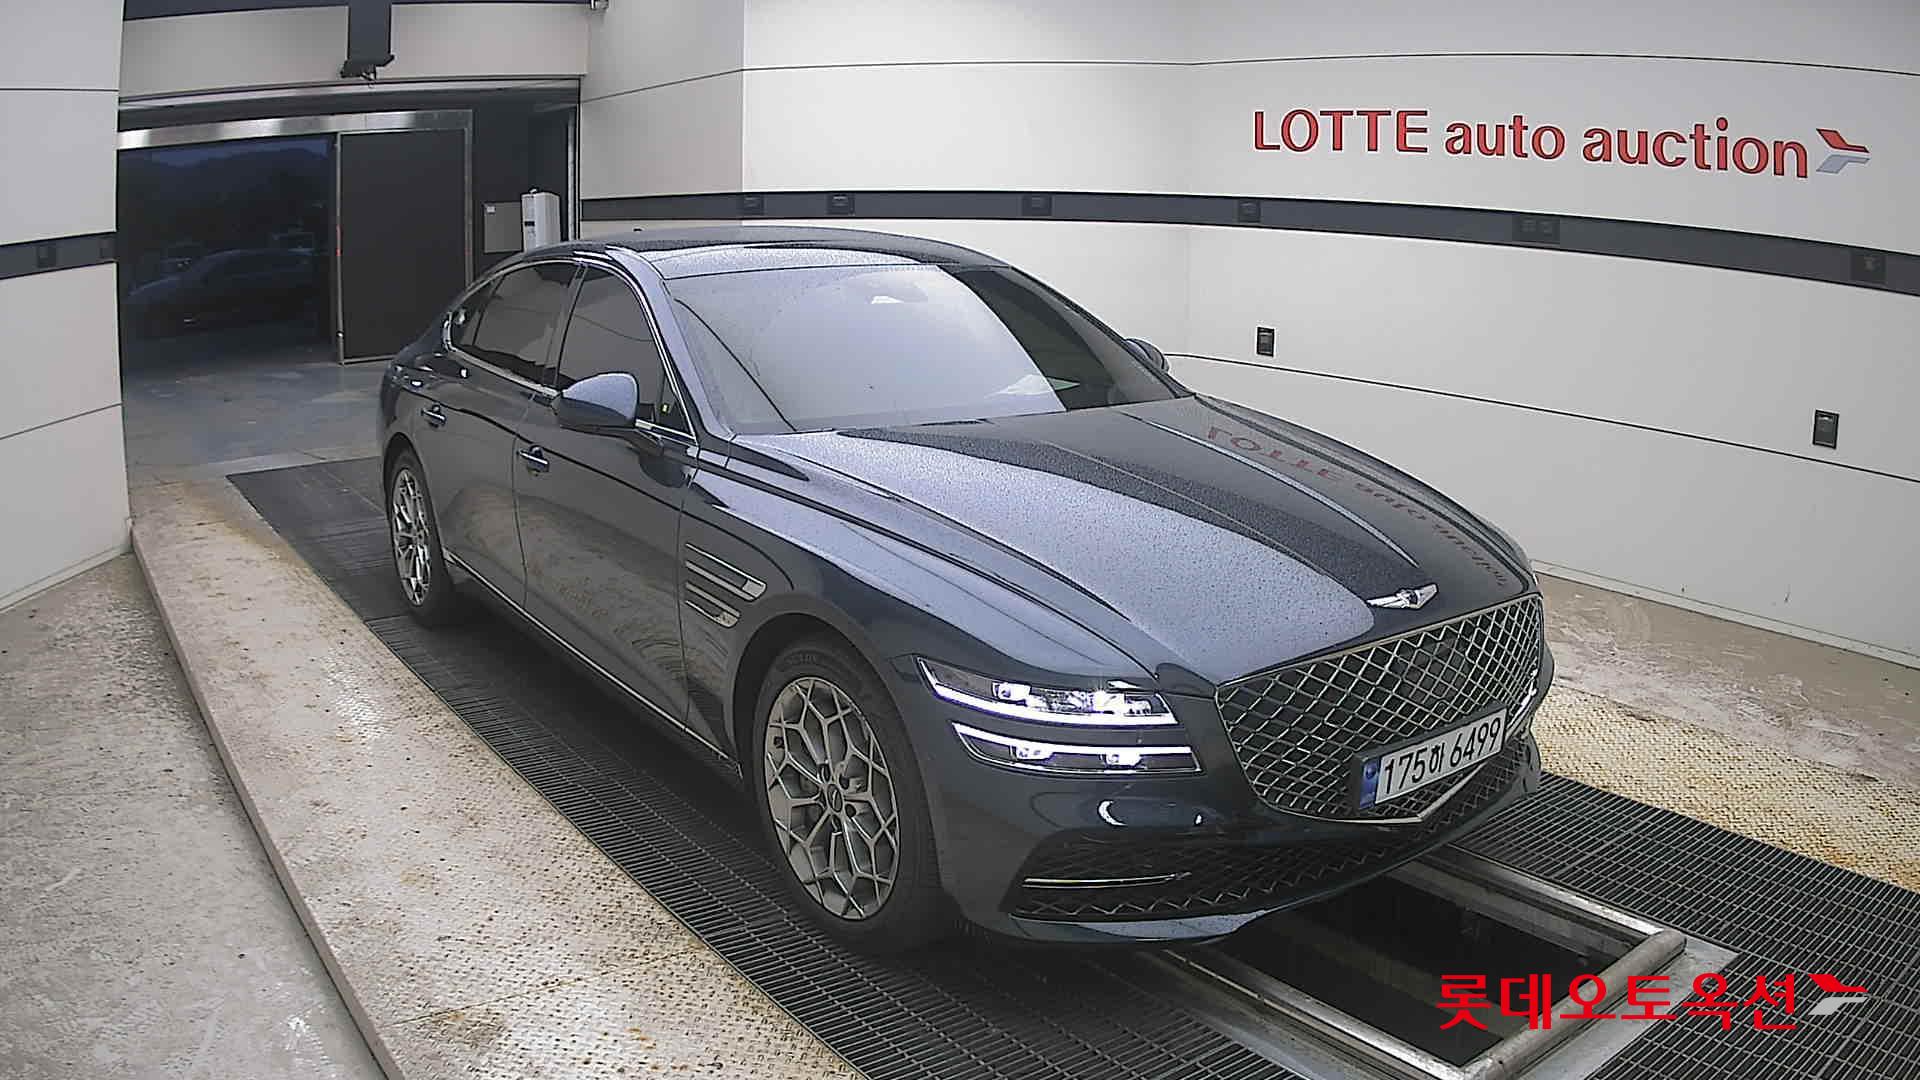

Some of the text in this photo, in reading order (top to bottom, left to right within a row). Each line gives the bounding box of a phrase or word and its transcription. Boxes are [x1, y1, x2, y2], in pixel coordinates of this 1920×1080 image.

[1254, 109, 1809, 179] LOTTE auto auction
[1449, 717, 1501, 768] 6499
